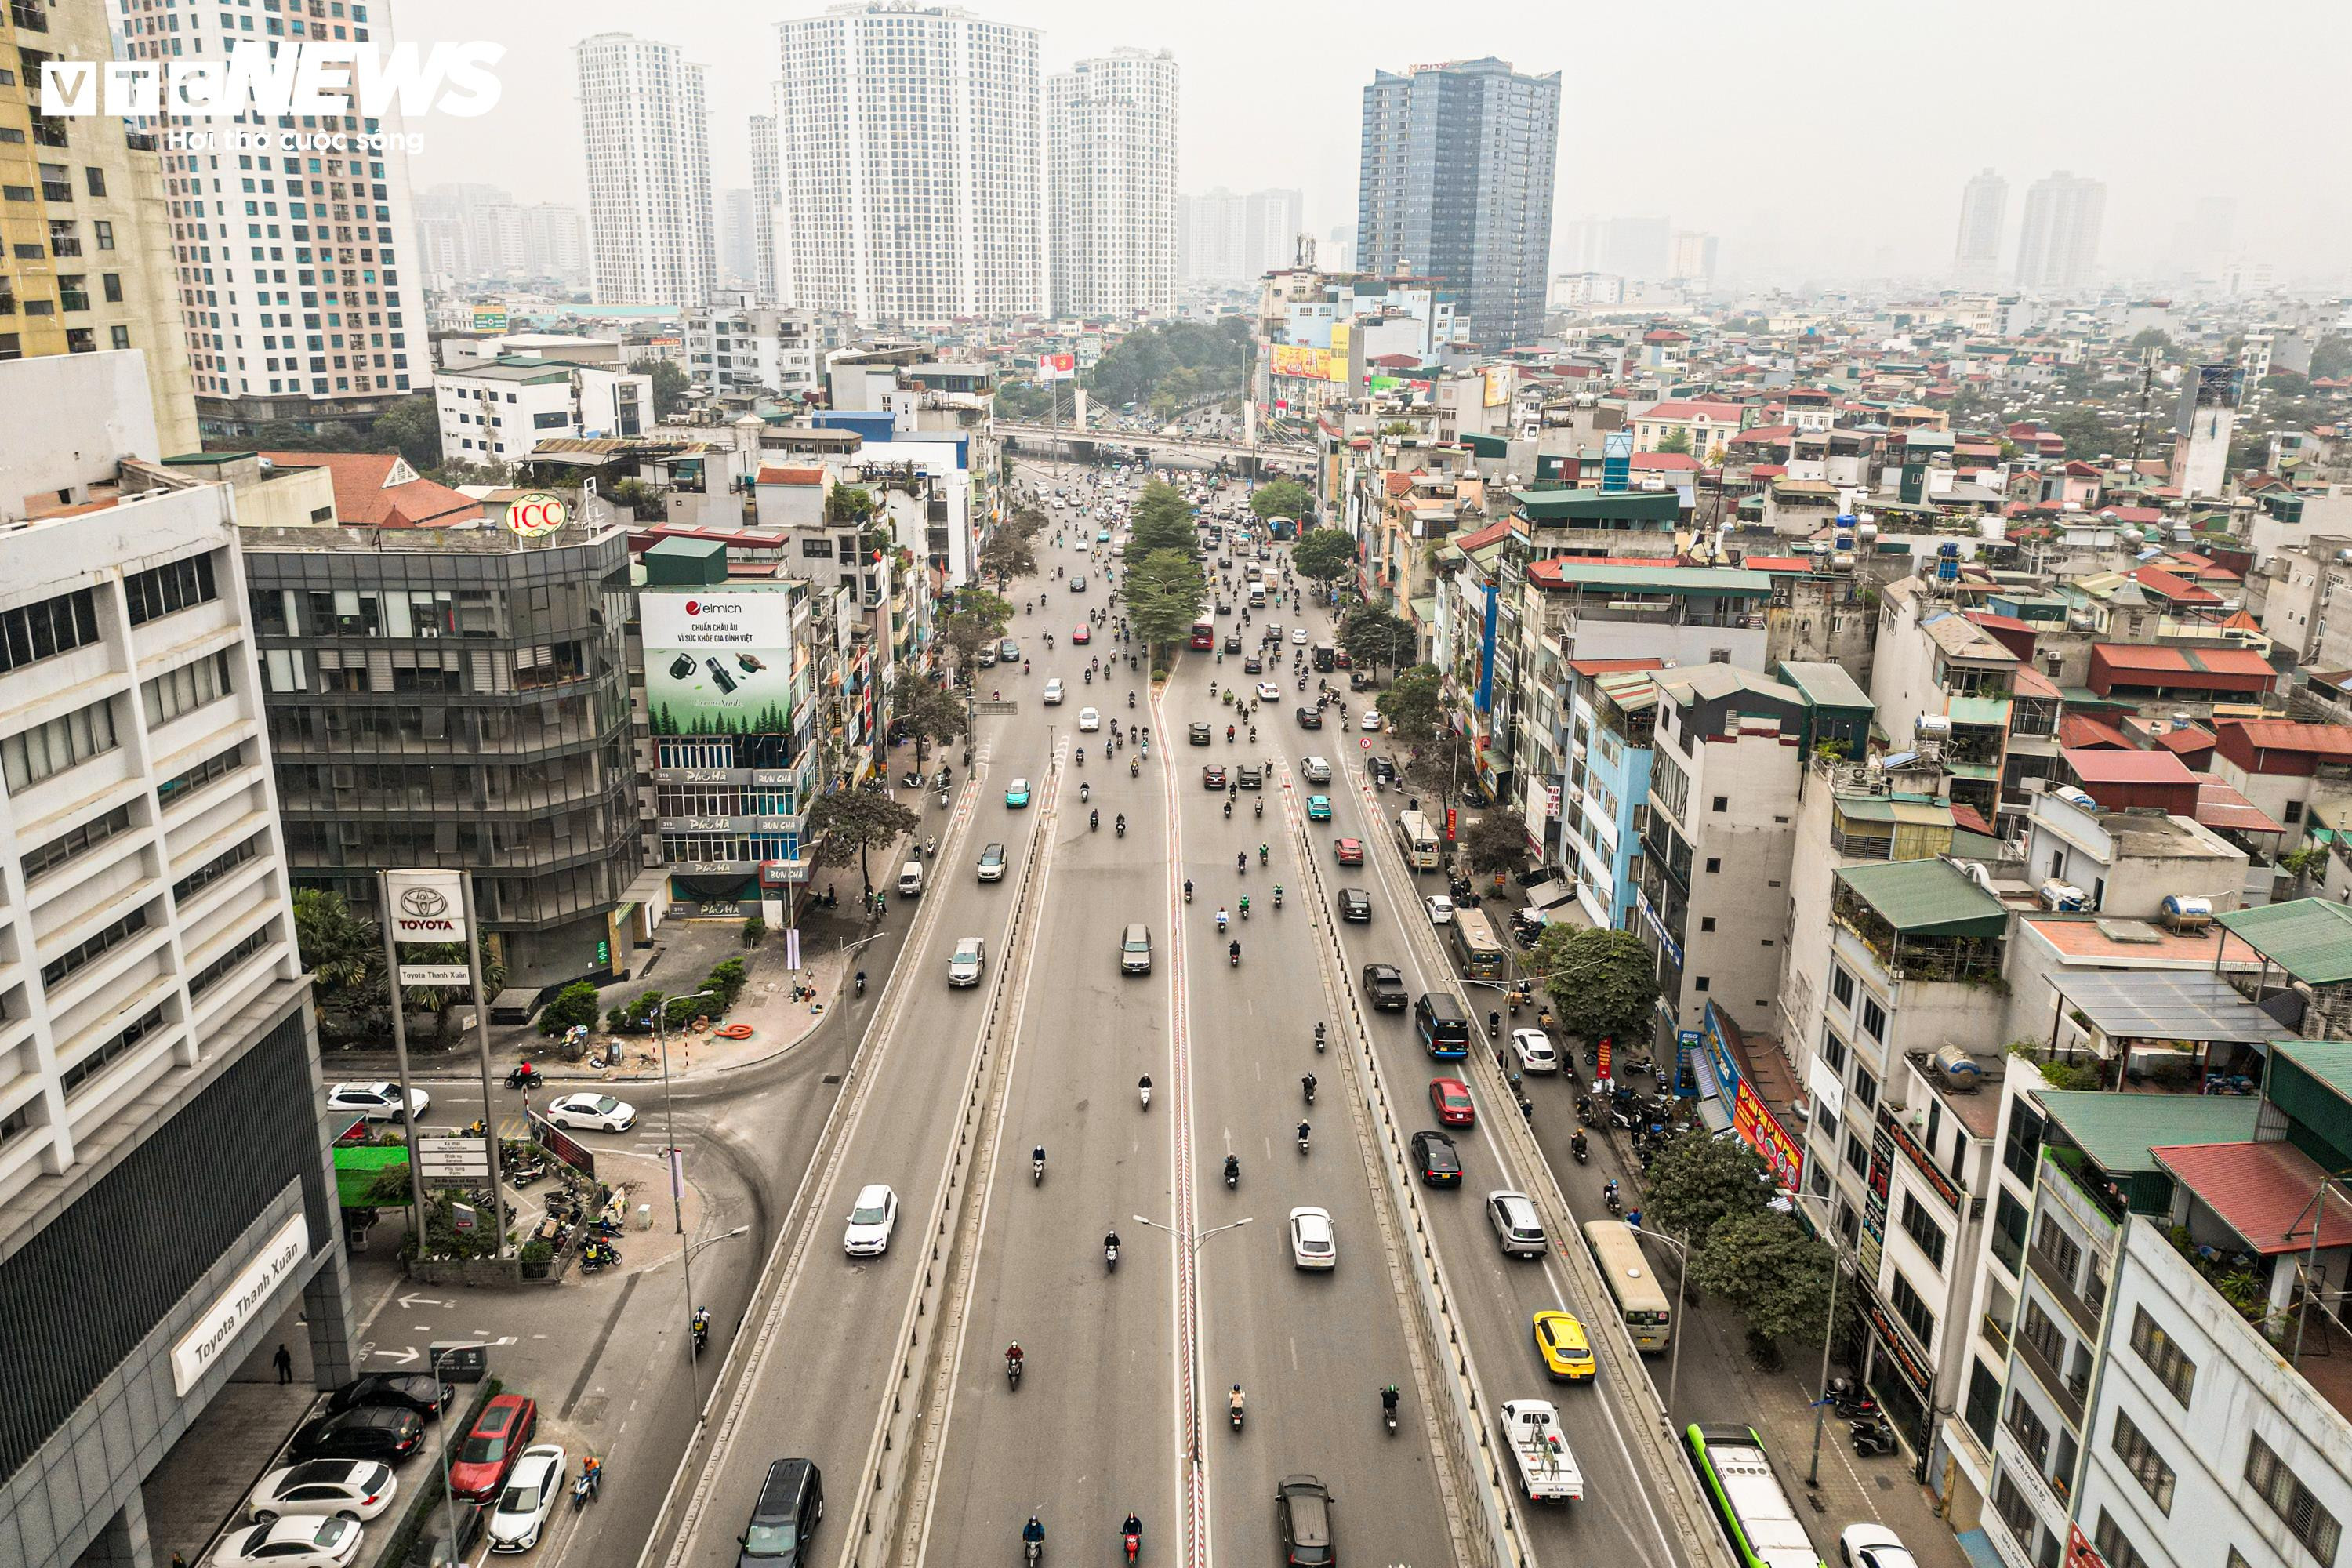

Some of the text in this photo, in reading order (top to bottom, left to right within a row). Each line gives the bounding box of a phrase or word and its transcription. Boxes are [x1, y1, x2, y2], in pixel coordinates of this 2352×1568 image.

[510, 502, 562, 529] ICC
[702, 603, 742, 613] elmich
[740, 633, 753, 643] VIỆT
[759, 773, 775, 783] BÚN
[763, 820, 779, 829] BÚN
[770, 869, 786, 878] BÚN
[399, 920, 454, 931] TOYOTA
[194, 1243, 298, 1365] Toyota Thanh Xuân
[359, 1341, 376, 1362] OUT
